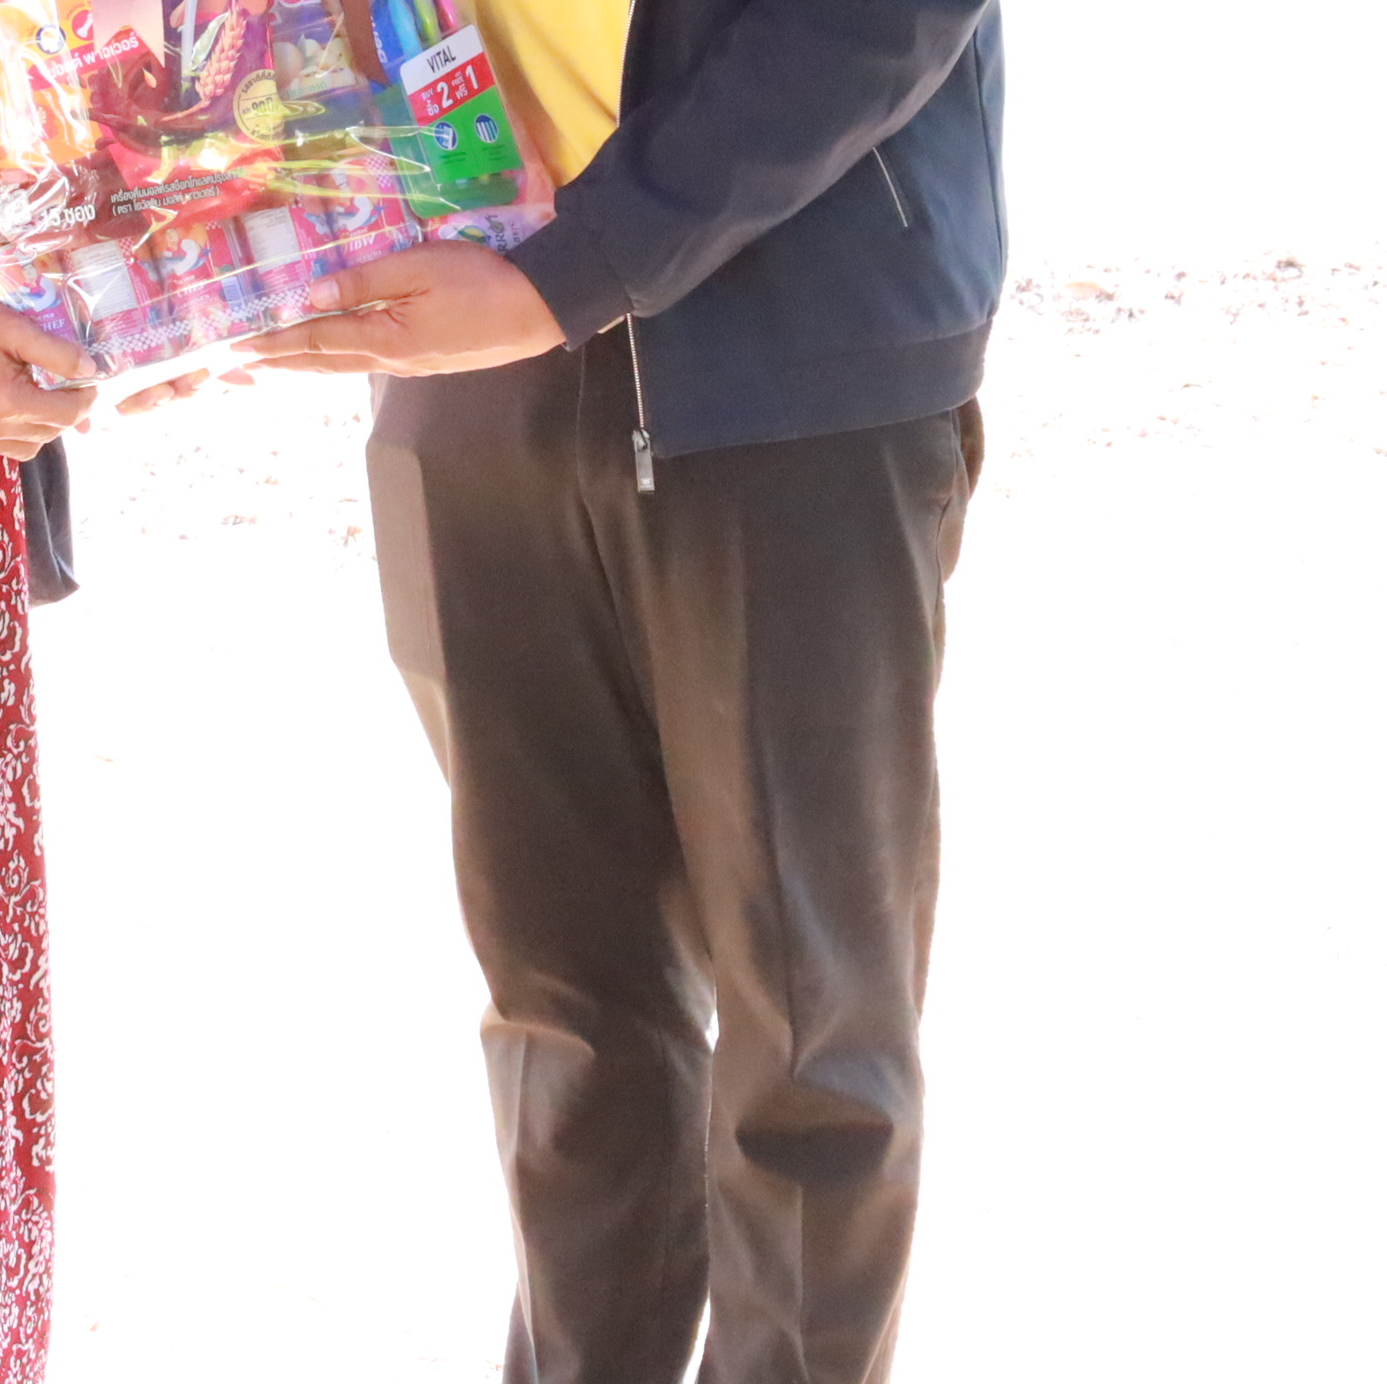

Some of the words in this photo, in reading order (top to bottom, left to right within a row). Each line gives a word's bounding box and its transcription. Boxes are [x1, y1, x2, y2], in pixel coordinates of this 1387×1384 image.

[427, 46, 457, 74] VITAL
[436, 81, 454, 109] 2
[465, 64, 479, 90] 1
